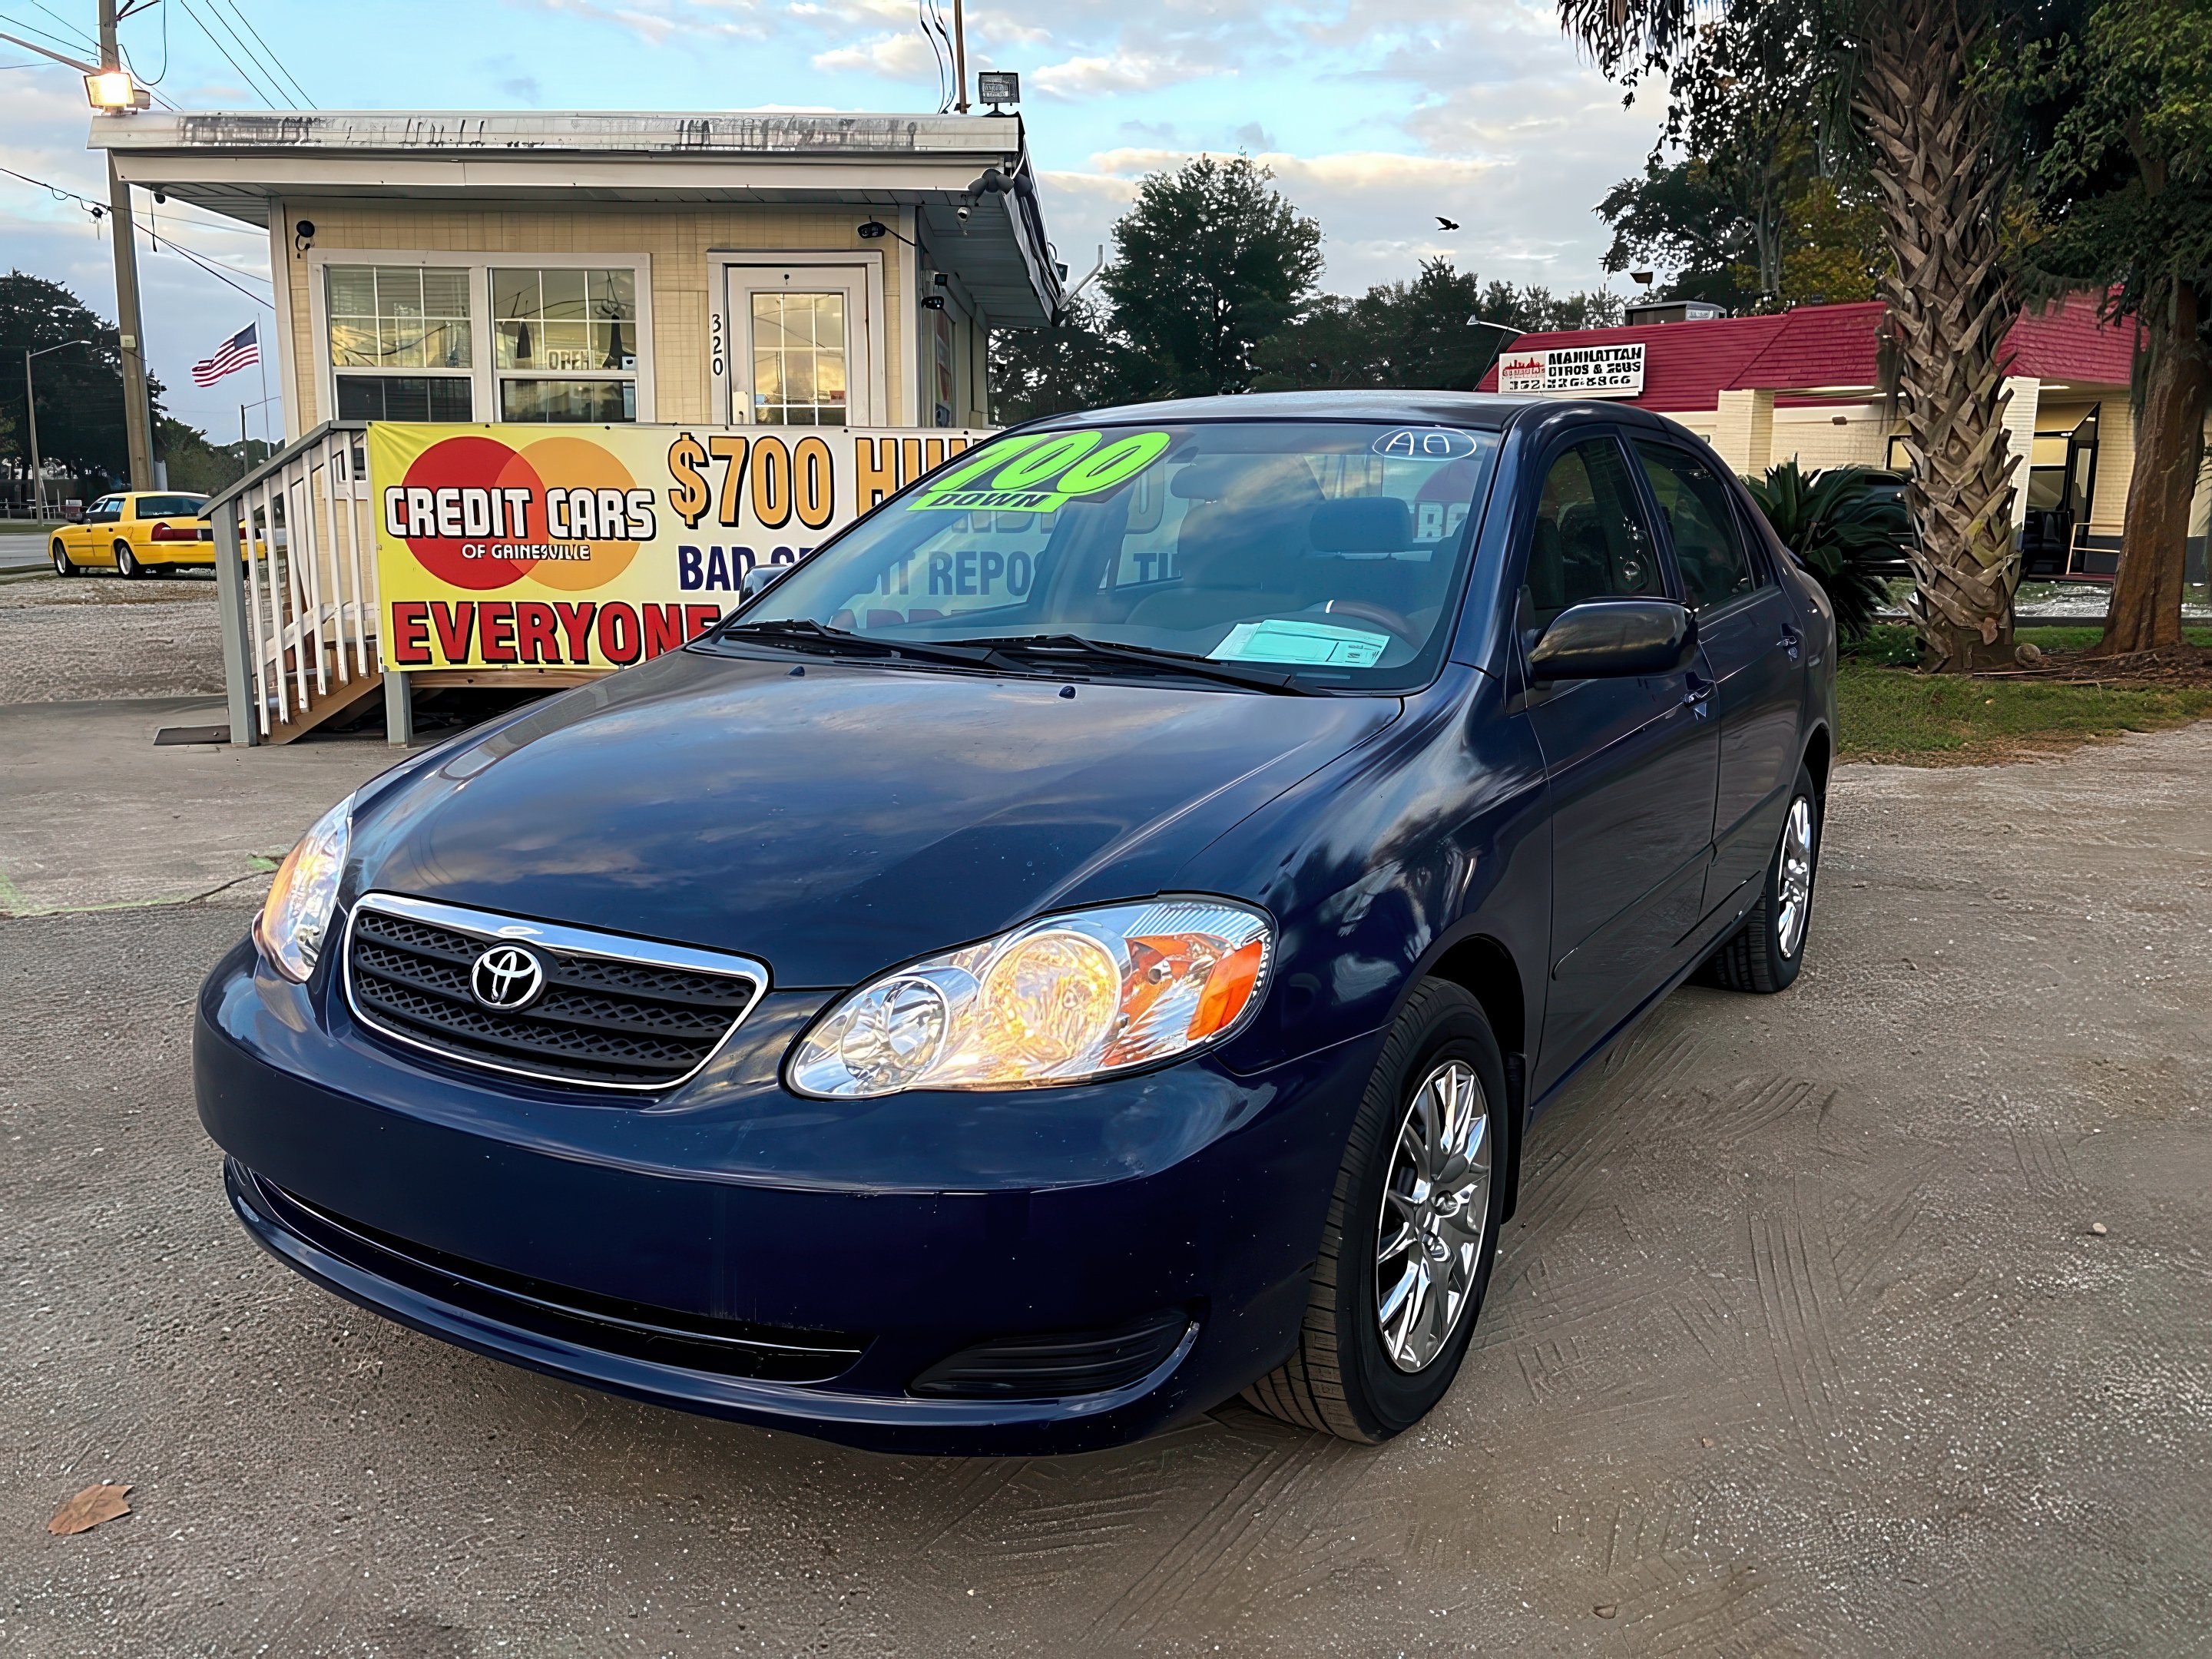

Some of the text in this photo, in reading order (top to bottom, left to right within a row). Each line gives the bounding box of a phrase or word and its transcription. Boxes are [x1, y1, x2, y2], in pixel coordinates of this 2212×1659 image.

[712, 313, 724, 376] 320
[1548, 346, 1642, 366] MANHATTAN
[1593, 363, 1603, 375] &
[667, 432, 835, 530] $700
[928, 430, 1172, 494] 700
[385, 485, 657, 541] CREDIT CARS
[926, 492, 1052, 508] DOWN
[462, 543, 591, 561] OF GAINESVILLE
[677, 545, 757, 591] BAD
